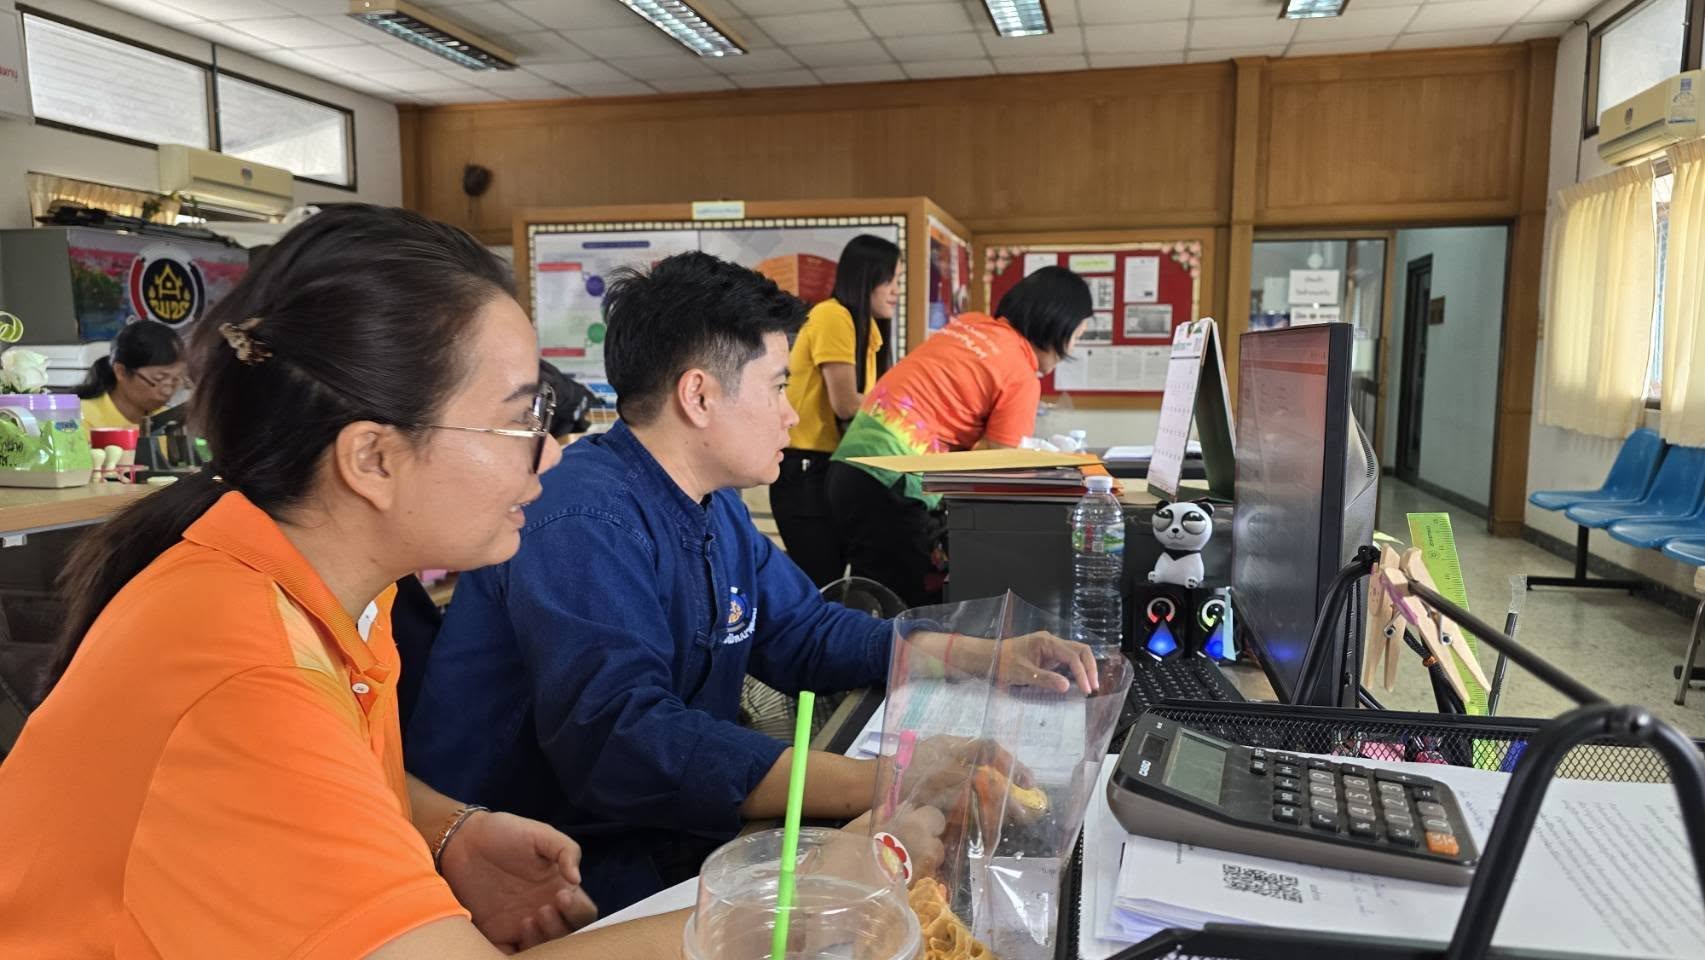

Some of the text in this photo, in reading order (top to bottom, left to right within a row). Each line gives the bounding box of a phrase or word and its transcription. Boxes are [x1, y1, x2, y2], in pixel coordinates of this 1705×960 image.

[1138, 760, 1151, 777] CASIO
[1312, 772, 1334, 808] 7 8 9
[1382, 784, 1401, 792] 3
[1384, 798, 1404, 807] 2
[1351, 806, 1370, 814] 4
[1426, 819, 1447, 828] 0
